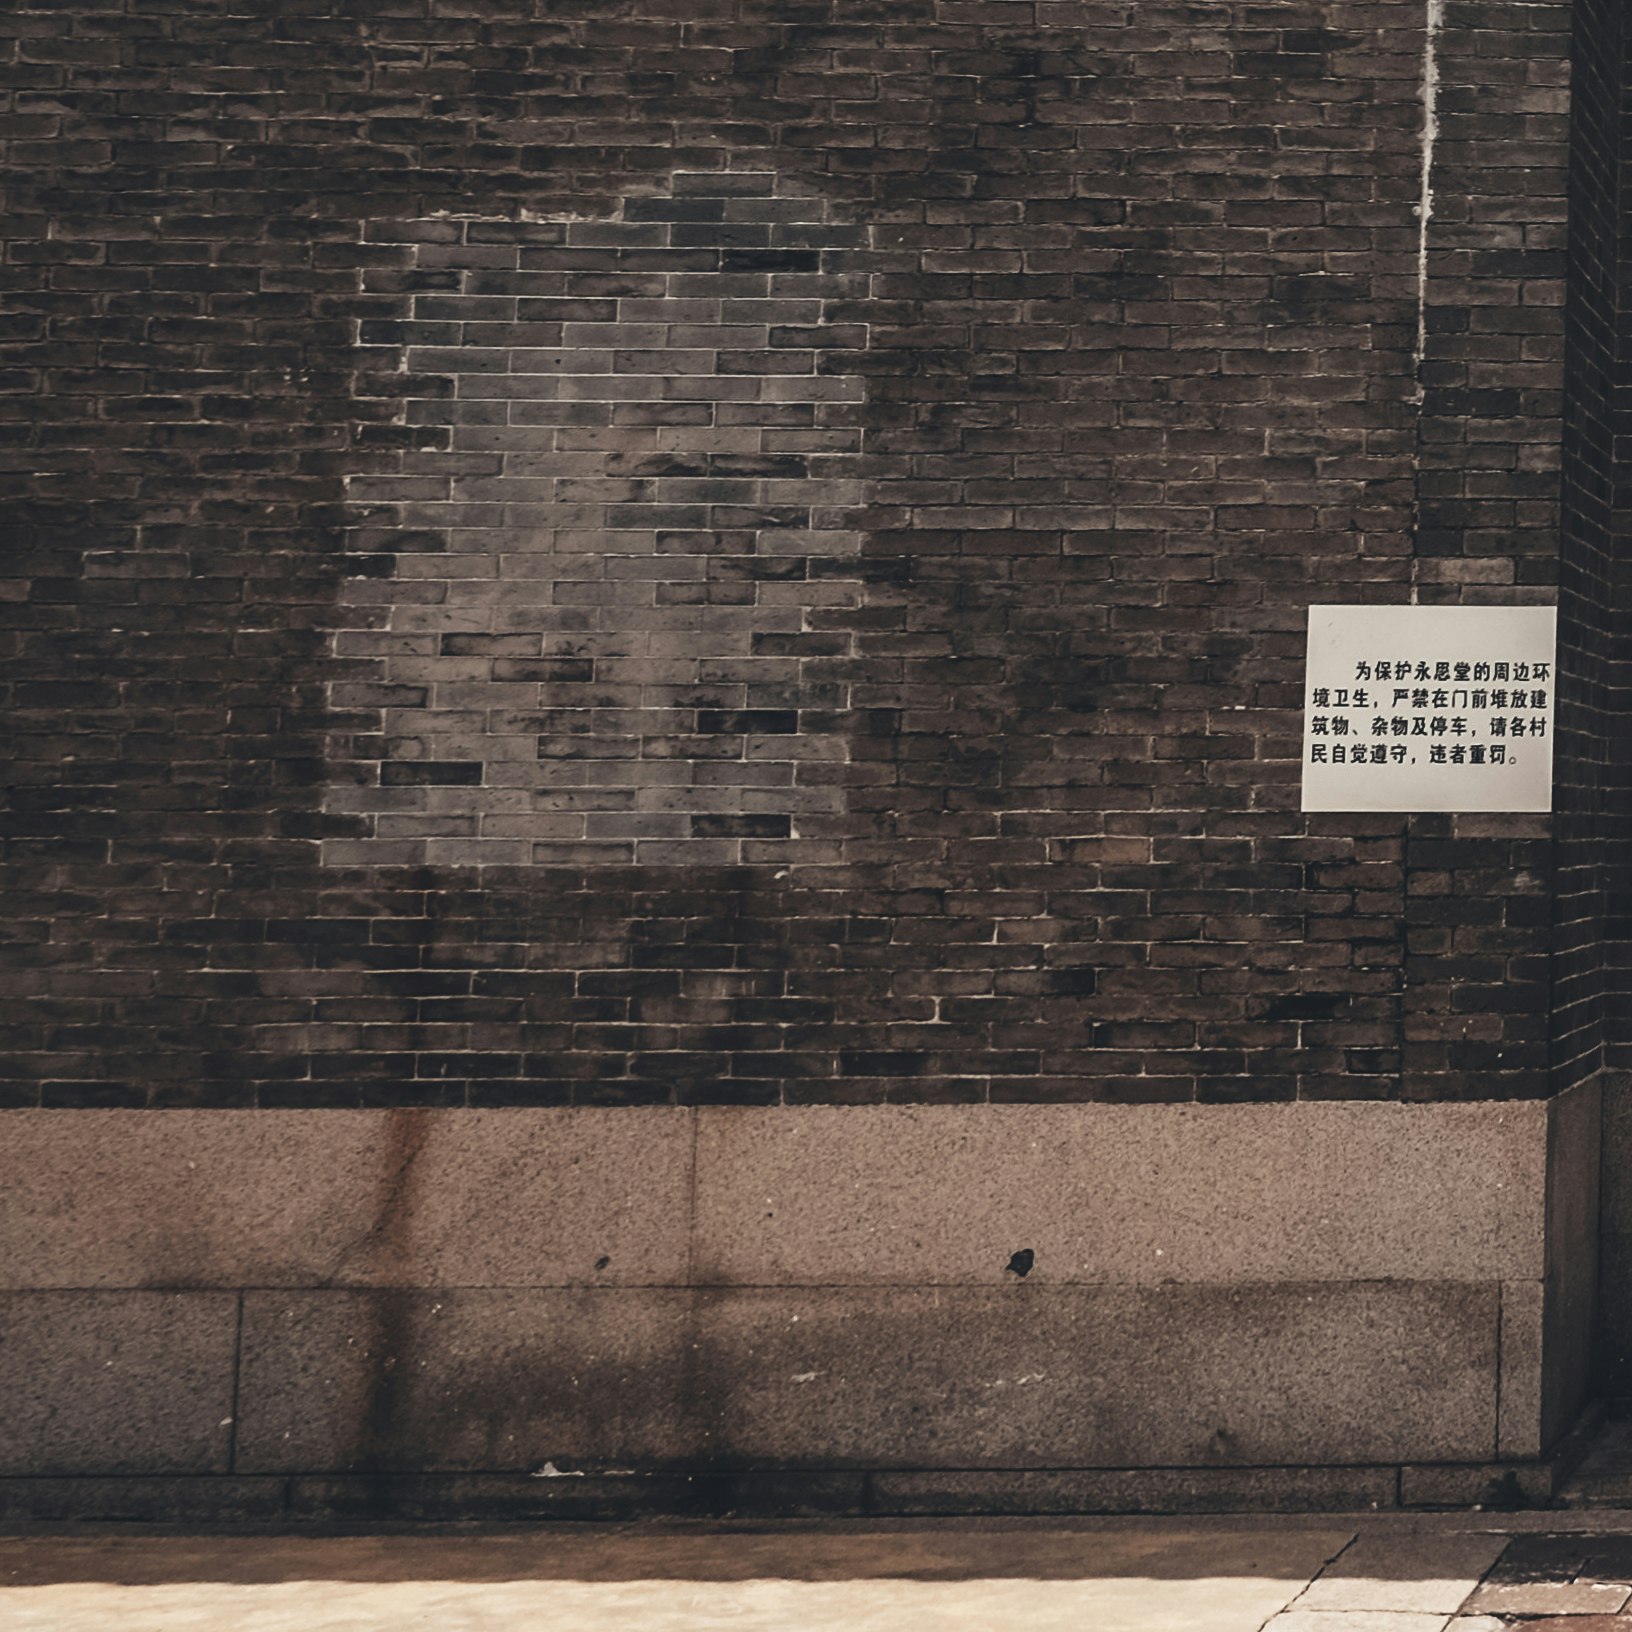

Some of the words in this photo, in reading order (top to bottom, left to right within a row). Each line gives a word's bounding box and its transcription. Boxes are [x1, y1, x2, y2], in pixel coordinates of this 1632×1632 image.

[1355, 660, 1551, 682] 为保护永思堂的周边环
[1312, 687, 1548, 709] 境卫生，严禁在门前堆放建
[1311, 715, 1547, 737] 筑物、杂物及停车，请各村
[1311, 743, 1517, 765] 民自觉遵守，违者重罚。
